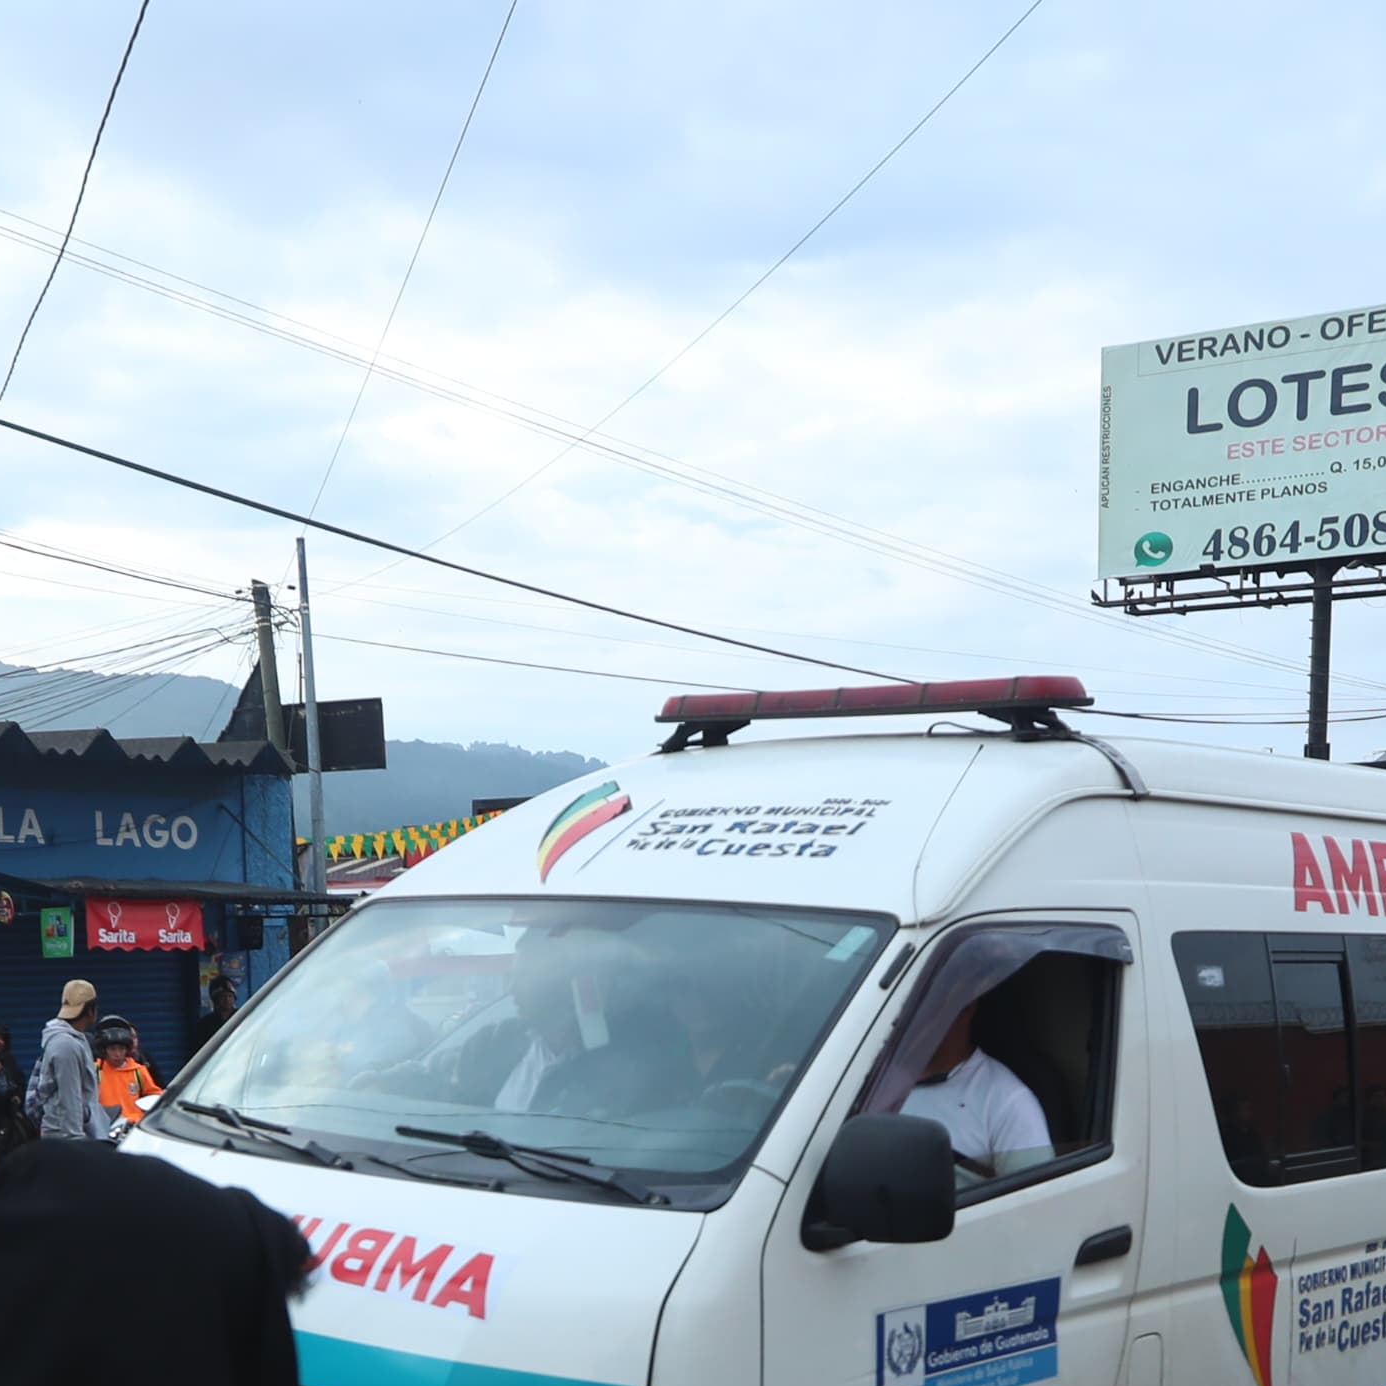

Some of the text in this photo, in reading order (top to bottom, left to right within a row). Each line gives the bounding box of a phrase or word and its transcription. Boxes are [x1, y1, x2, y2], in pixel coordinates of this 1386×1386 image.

[1155, 325, 1291, 366] VERANO
[1100, 385, 1112, 509] APLICAN RESTRICCIONES
[1227, 436, 1286, 461] ESTE
[1329, 459, 1348, 475] Q.
[1150, 482, 1328, 513] TOTALMENTE PLANOS
[764, 806, 877, 818] MUNICIPAL
[94, 809, 199, 850] LAGO
[638, 820, 868, 837] San Rafael
[696, 838, 839, 858] Cuesta
[98, 927, 193, 944] Sarita Sarita
[1298, 1265, 1348, 1294] GOBIERNO
[1298, 1298, 1334, 1329] San
[927, 1326, 1049, 1368] Gobierno de Guatemala
